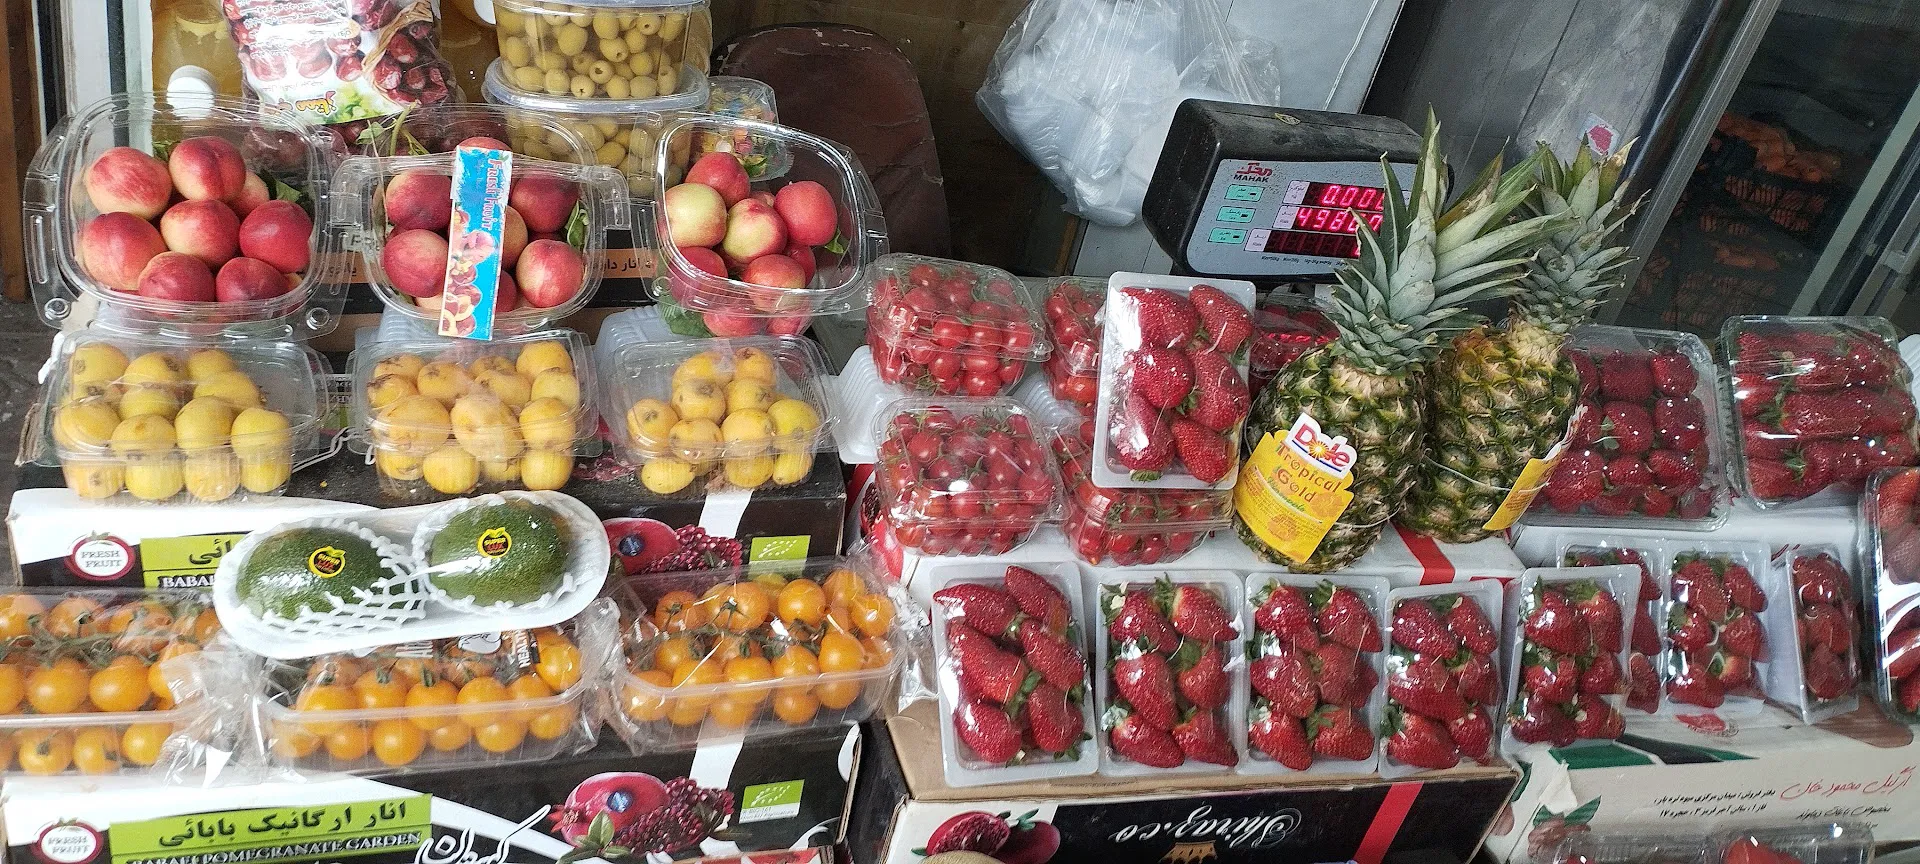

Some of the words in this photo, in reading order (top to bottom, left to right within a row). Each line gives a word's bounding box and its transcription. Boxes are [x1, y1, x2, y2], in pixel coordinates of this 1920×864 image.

[1233, 174, 1270, 183] MAHAK
[1294, 423, 1351, 467] Dole
[1276, 440, 1342, 493] Tropical
[1276, 467, 1318, 503] Gold
[81, 550, 121, 559] FRESH
[86, 559, 123, 568] FRUIT
[248, 805, 352, 837] ارگانیک
[364, 800, 406, 829] انار
[1109, 804, 1302, 849] Shiraz.co
[159, 815, 236, 847] بابائی
[203, 839, 343, 864] POMEGRANATE
[346, 832, 422, 850] GARDEN
